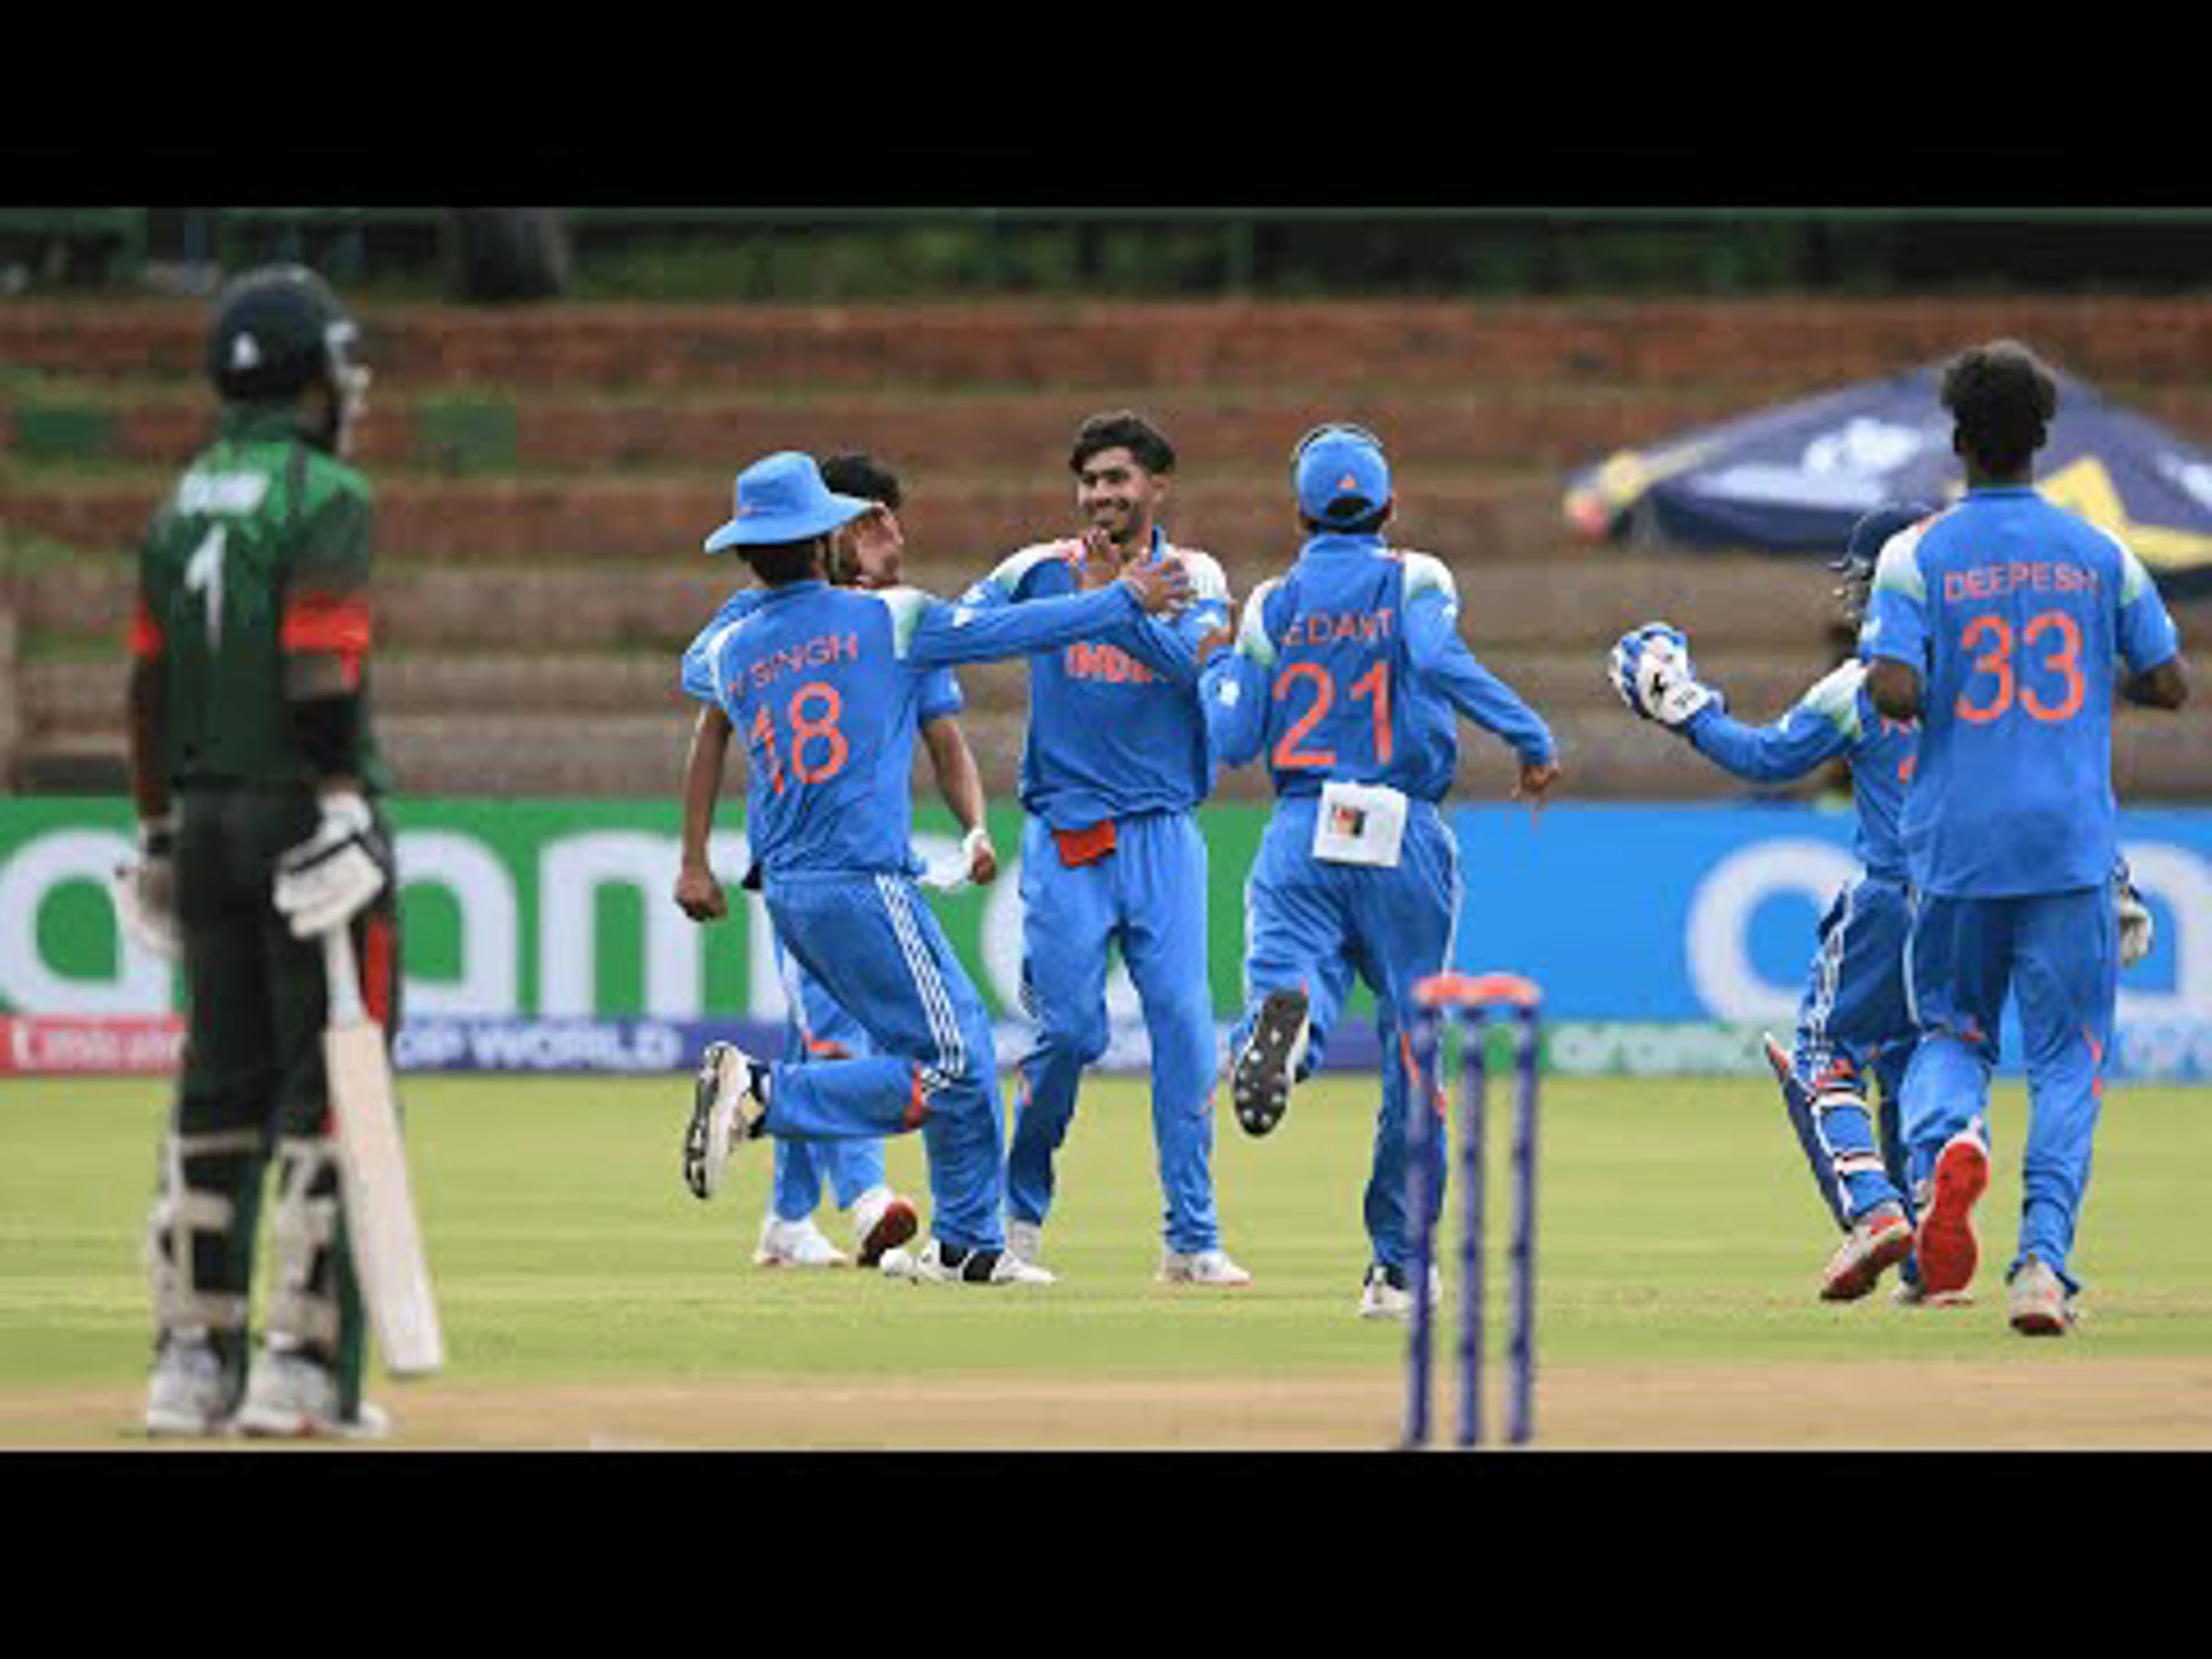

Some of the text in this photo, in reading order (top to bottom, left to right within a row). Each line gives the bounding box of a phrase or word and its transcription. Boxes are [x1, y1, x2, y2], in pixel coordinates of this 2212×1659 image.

[184, 521, 228, 654] 1
[1944, 561, 2100, 600] DEEPESH
[750, 634, 858, 689] SINGH
[1954, 612, 2084, 721] 33
[751, 681, 849, 794] 18
[1272, 662, 1393, 766] 21
[471, 1025, 681, 1069] WORLD
